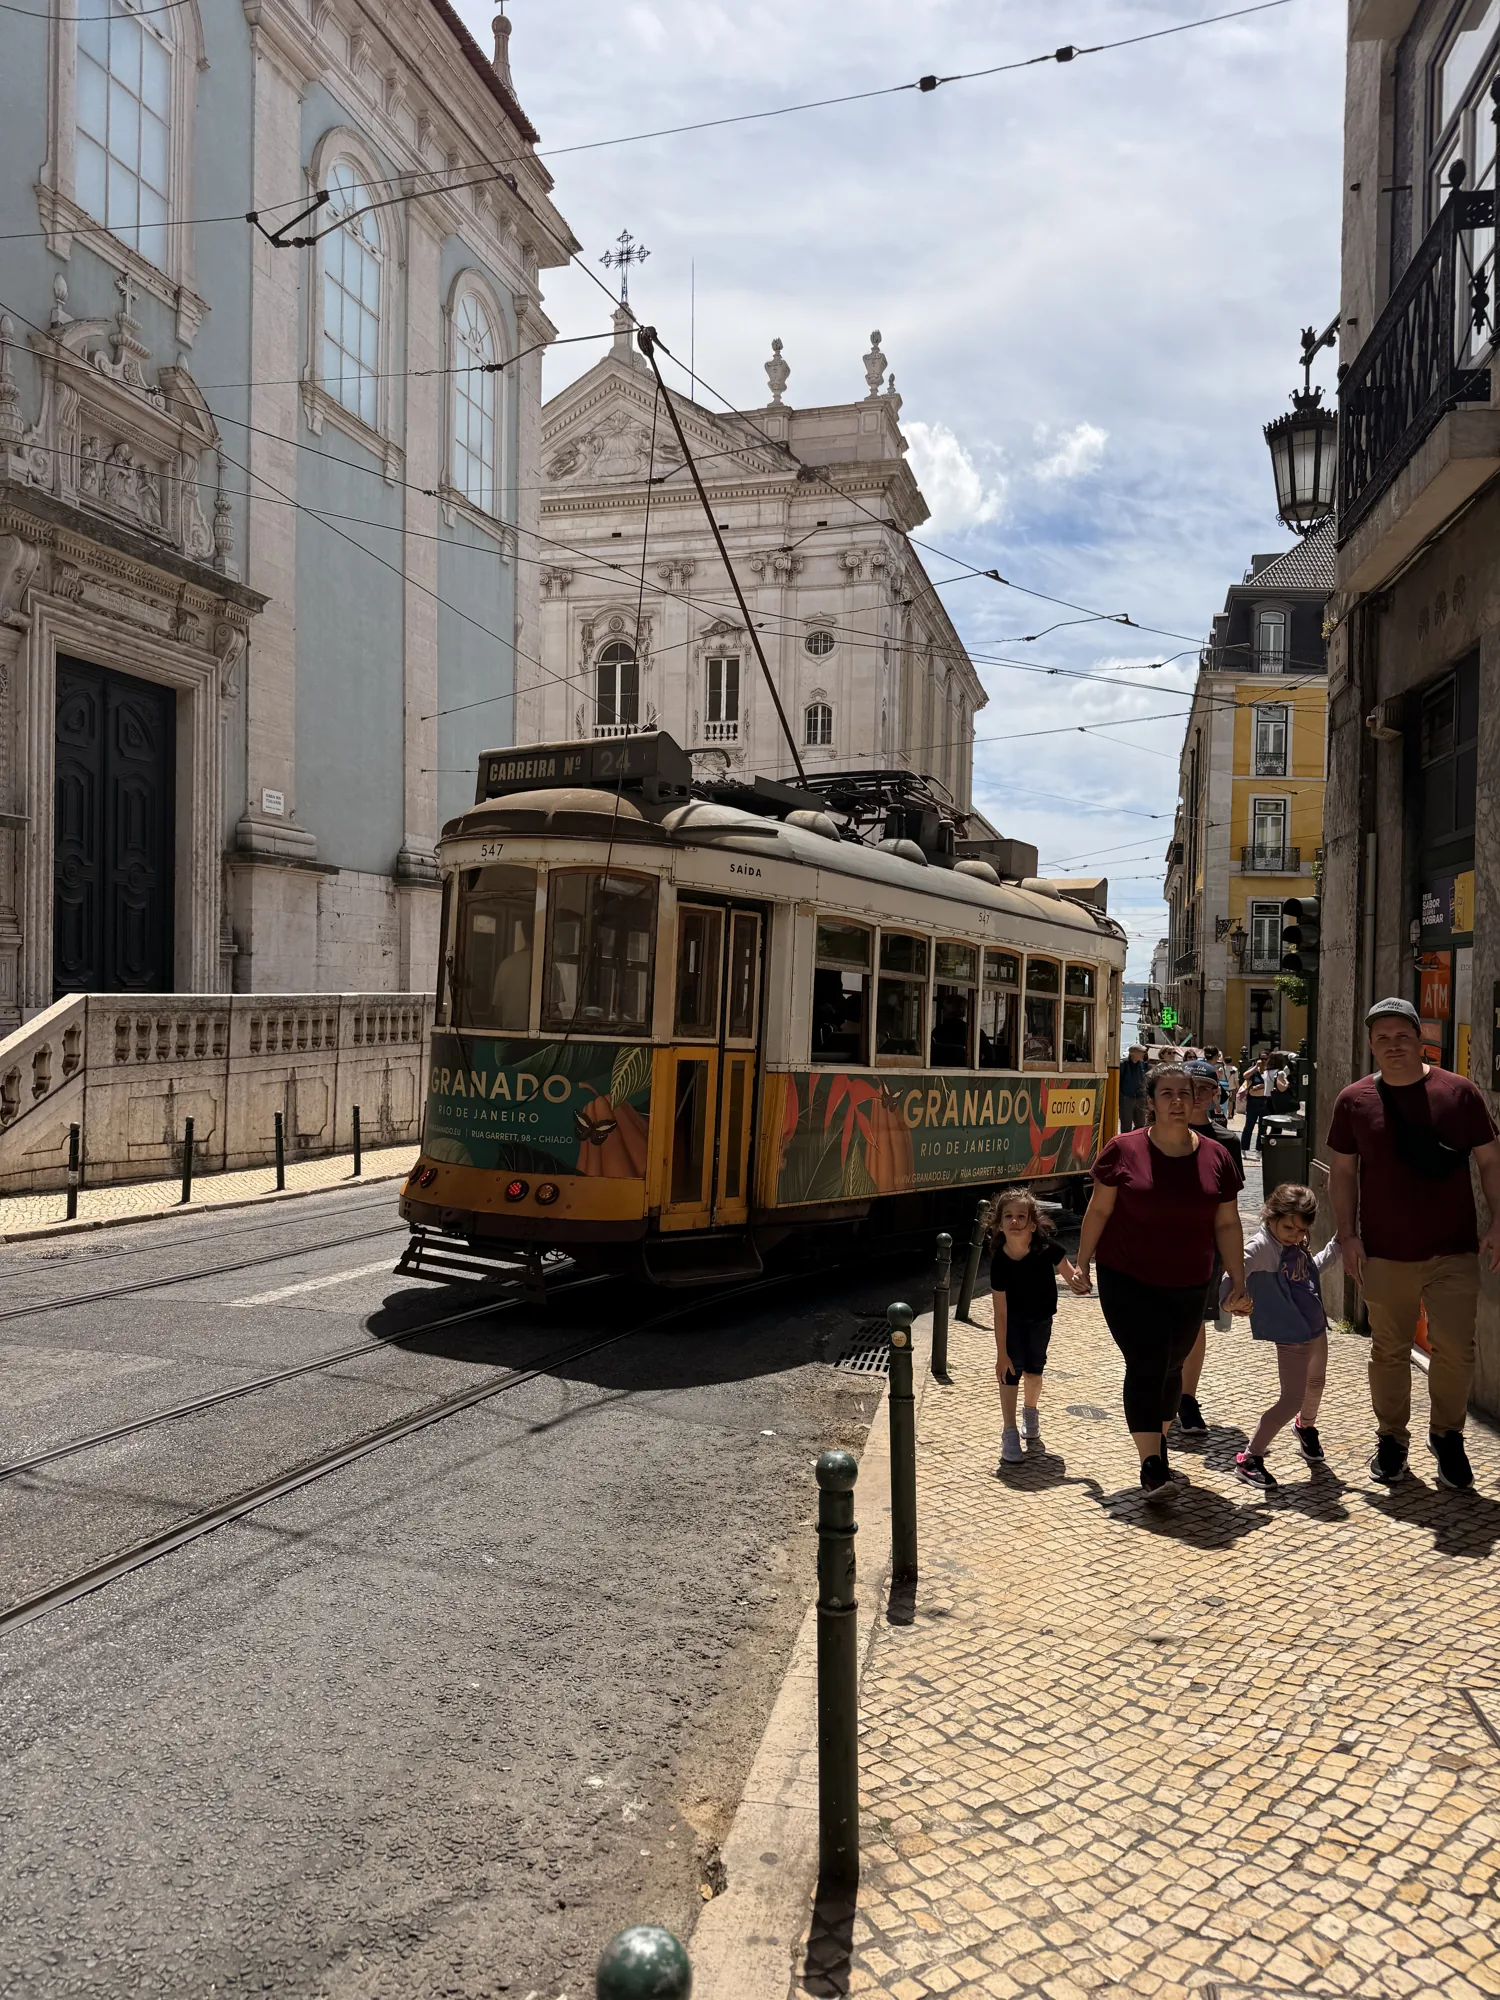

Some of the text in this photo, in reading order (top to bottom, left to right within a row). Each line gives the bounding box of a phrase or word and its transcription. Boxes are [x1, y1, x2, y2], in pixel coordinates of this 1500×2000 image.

[489, 748, 631, 782] CARREIRA Nº 24
[481, 843, 503, 857] 547
[729, 863, 762, 878] SAÍDA
[1422, 898, 1440, 910] SABOR
[978, 911, 990, 926] 547
[1422, 913, 1444, 926] DOBRAR
[1424, 983, 1448, 1009] ATM
[431, 1066, 572, 1103] GRANADO
[438, 1104, 539, 1124] RIO DE JANEIRO
[903, 1088, 1029, 1129] GRANADO
[1051, 1097, 1075, 1115] carris
[471, 1129, 484, 1140] RUA
[485, 1131, 519, 1143] GARRETT,
[521, 1134, 531, 1142] 98
[538, 1135, 573, 1144] CHIADO
[920, 1137, 1010, 1157] RIO DE JANEIRO
[960, 1168, 971, 1178] RUA
[997, 1165, 1004, 1174] 98
